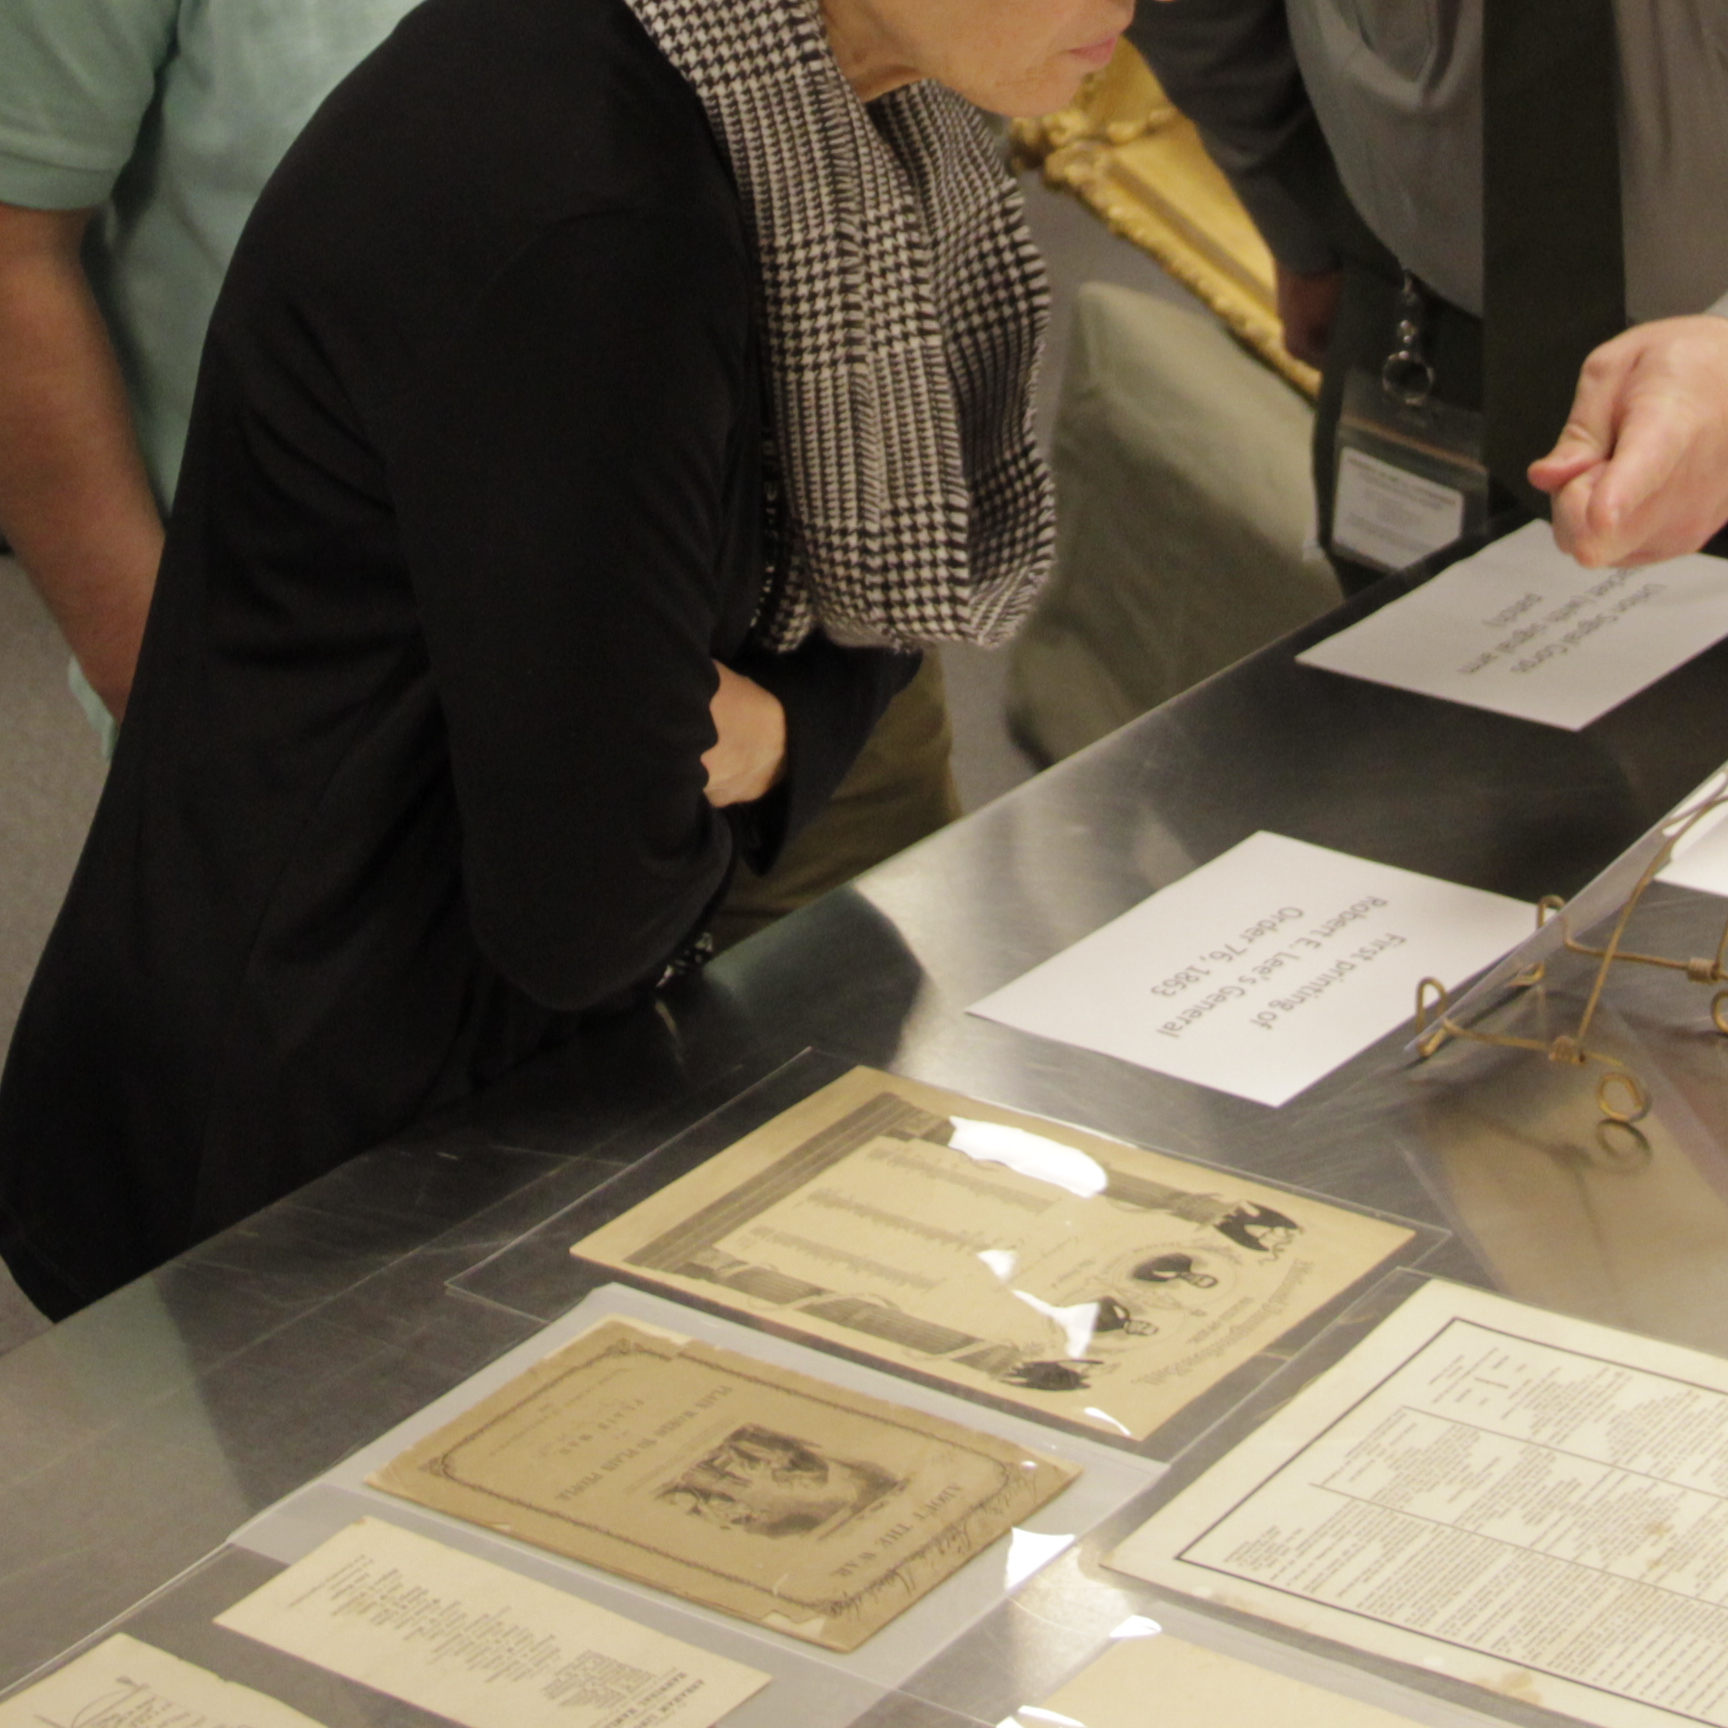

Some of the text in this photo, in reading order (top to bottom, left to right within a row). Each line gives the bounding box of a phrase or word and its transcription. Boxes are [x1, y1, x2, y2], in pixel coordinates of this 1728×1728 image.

[1561, 613, 1618, 644] Signal
[1457, 652, 1498, 674] arm
[1510, 643, 1568, 673] Corps
[1150, 905, 1305, 997] Order 76, 1863
[1156, 895, 1389, 1038] Robert E. Lee's General
[1250, 932, 1407, 1029] First printing of
[694, 1384, 734, 1409] PLAIN
[601, 1447, 641, 1472] PLAIN
[914, 1482, 963, 1522] ABOUT
[878, 1522, 914, 1549] THE
